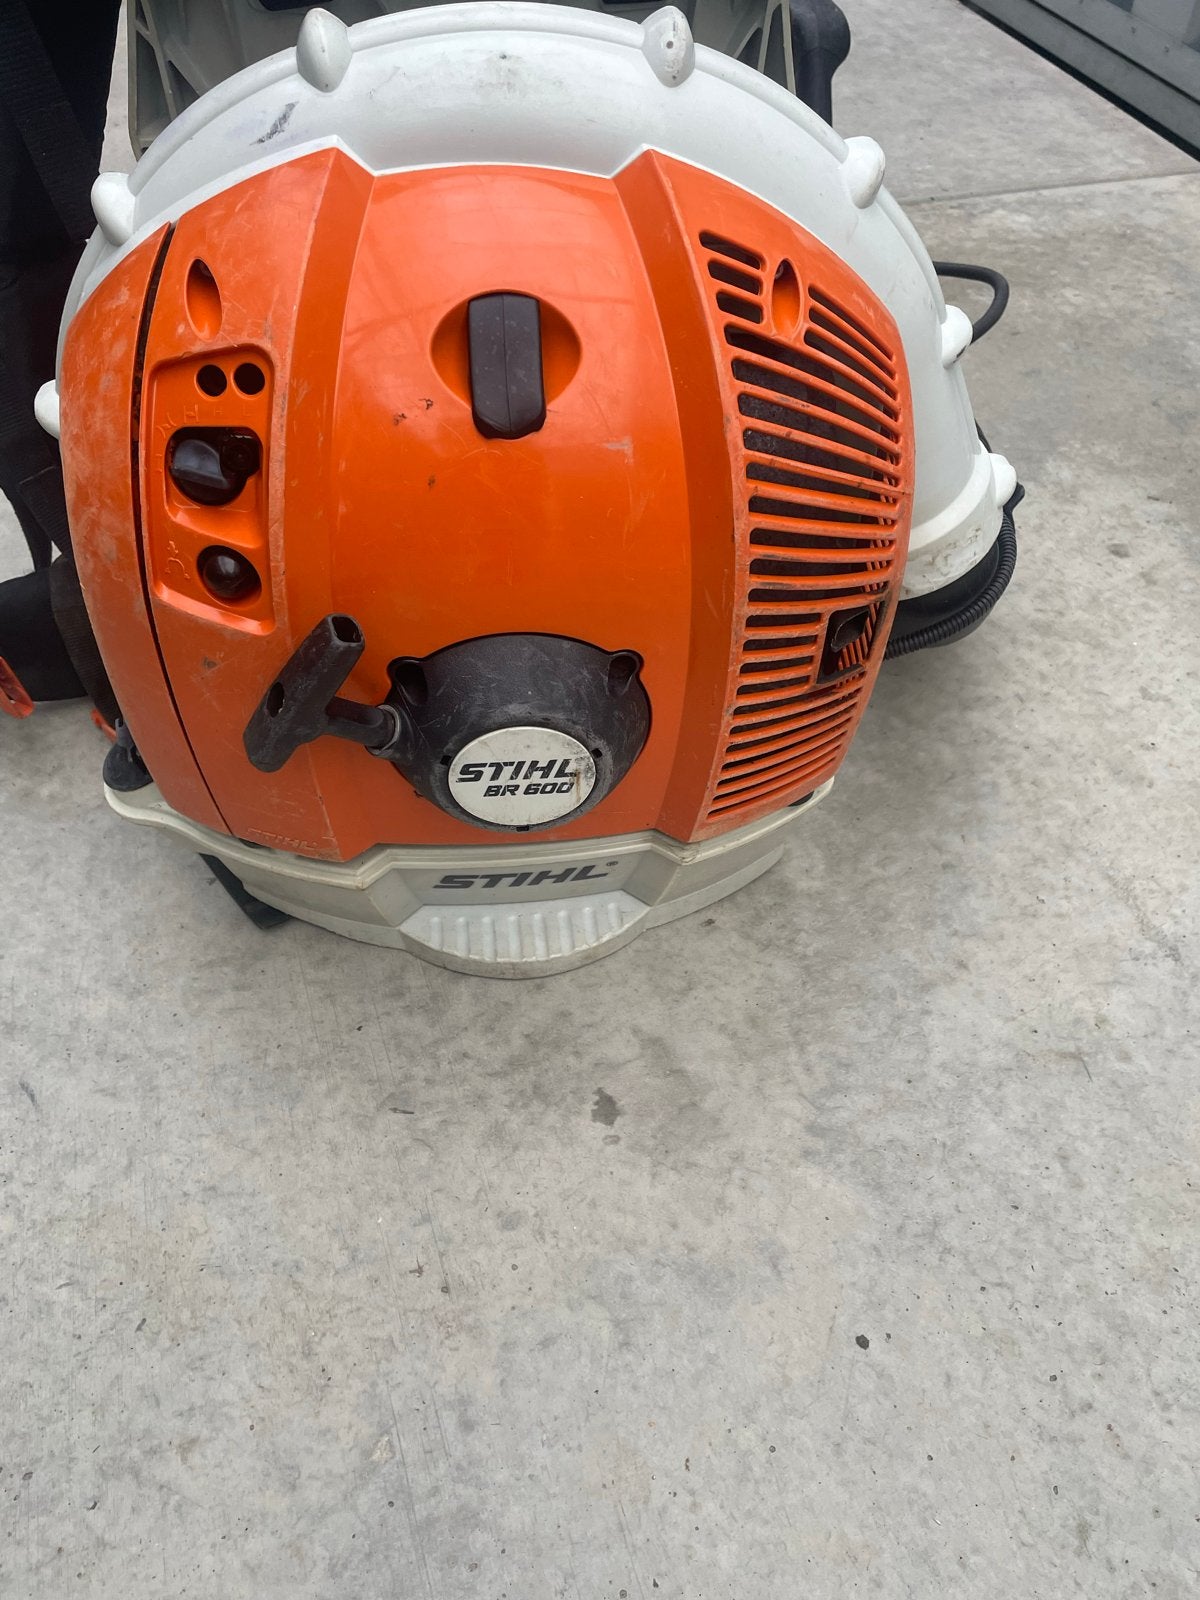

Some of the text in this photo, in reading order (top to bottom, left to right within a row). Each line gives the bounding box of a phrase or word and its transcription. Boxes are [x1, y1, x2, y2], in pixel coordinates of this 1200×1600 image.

[456, 758, 577, 783] STIHL
[483, 782, 574, 797] BR 600
